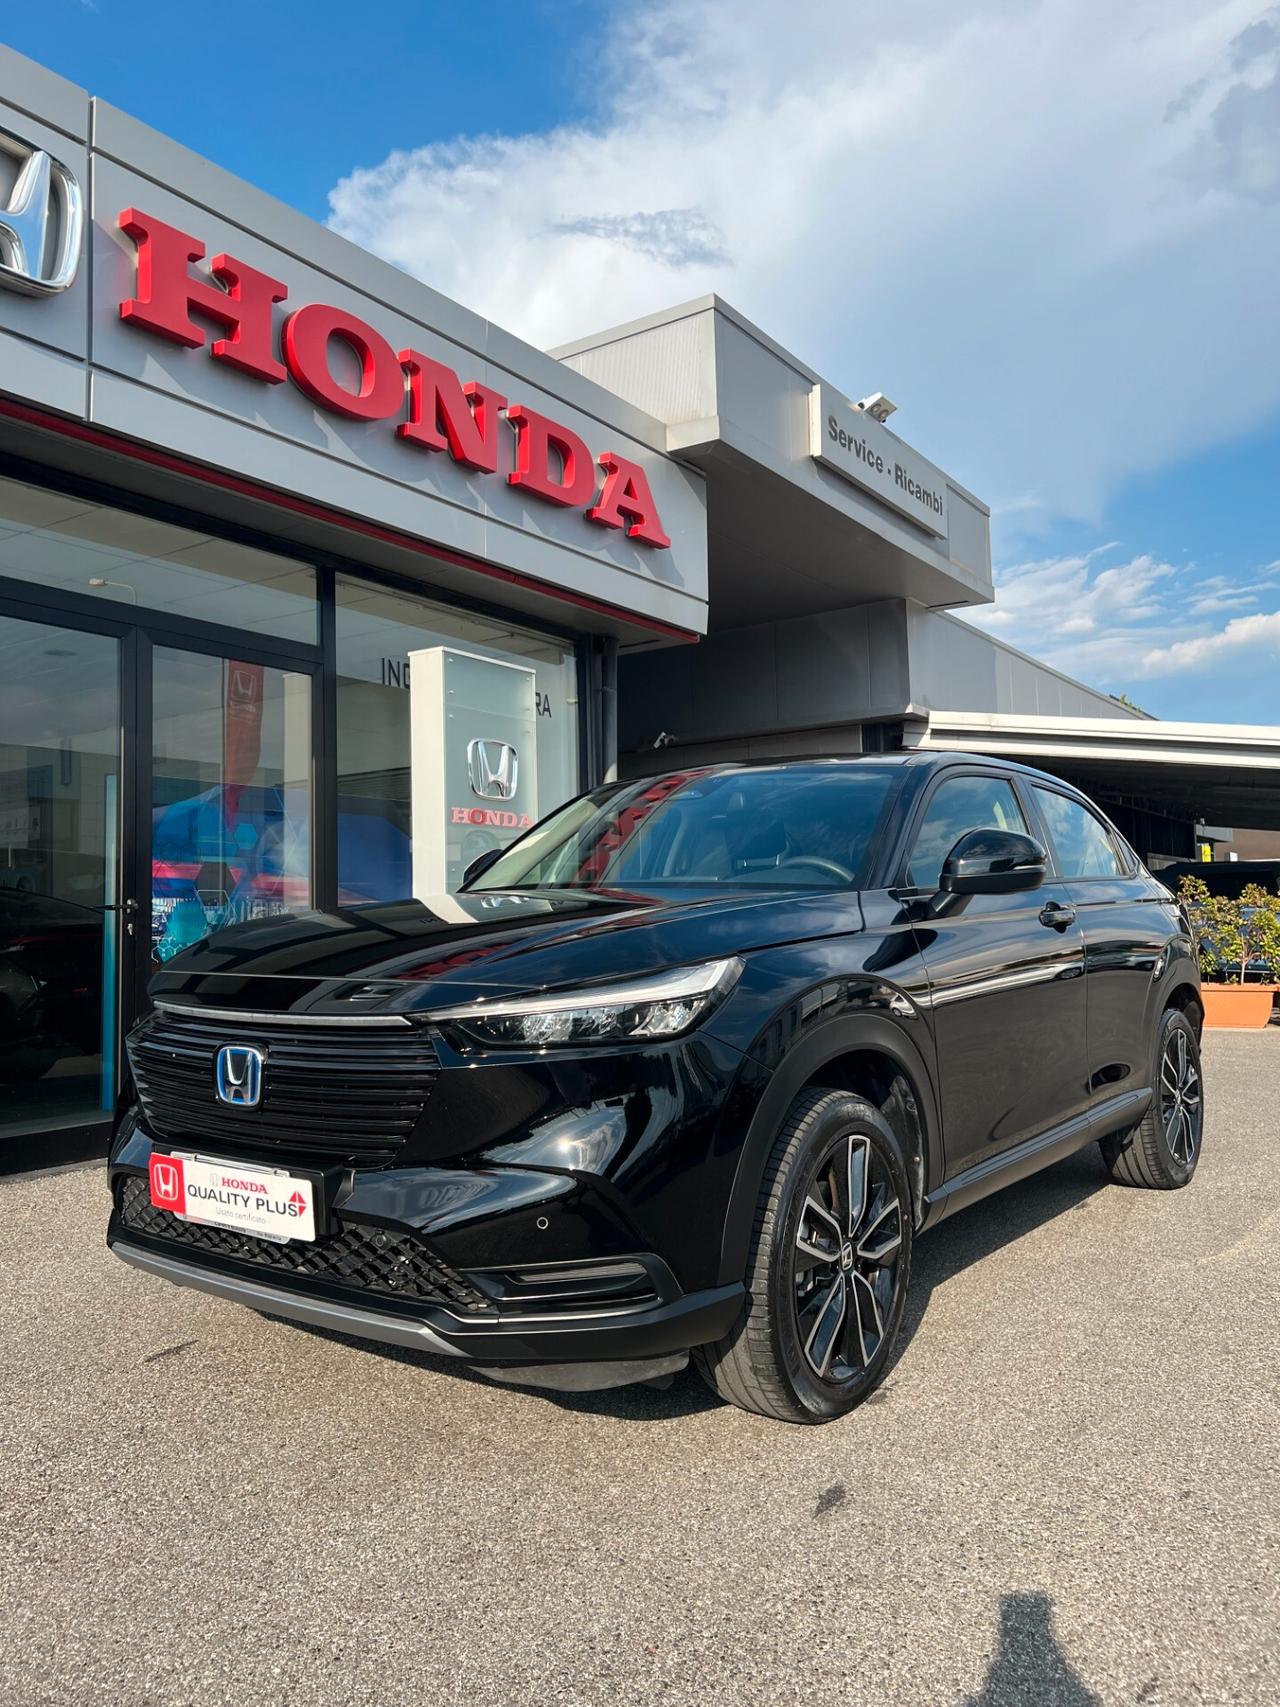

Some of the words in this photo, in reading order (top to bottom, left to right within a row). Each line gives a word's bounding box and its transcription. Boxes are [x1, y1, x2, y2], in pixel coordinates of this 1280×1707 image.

[119, 207, 670, 549] HONDA
[828, 415, 884, 473] Service
[895, 463, 943, 516] Ricambi
[451, 807, 535, 828] HONDA
[187, 1184, 250, 1208] QUALITY
[255, 1198, 298, 1217] PLUS
[221, 1177, 268, 1195] HONDA
